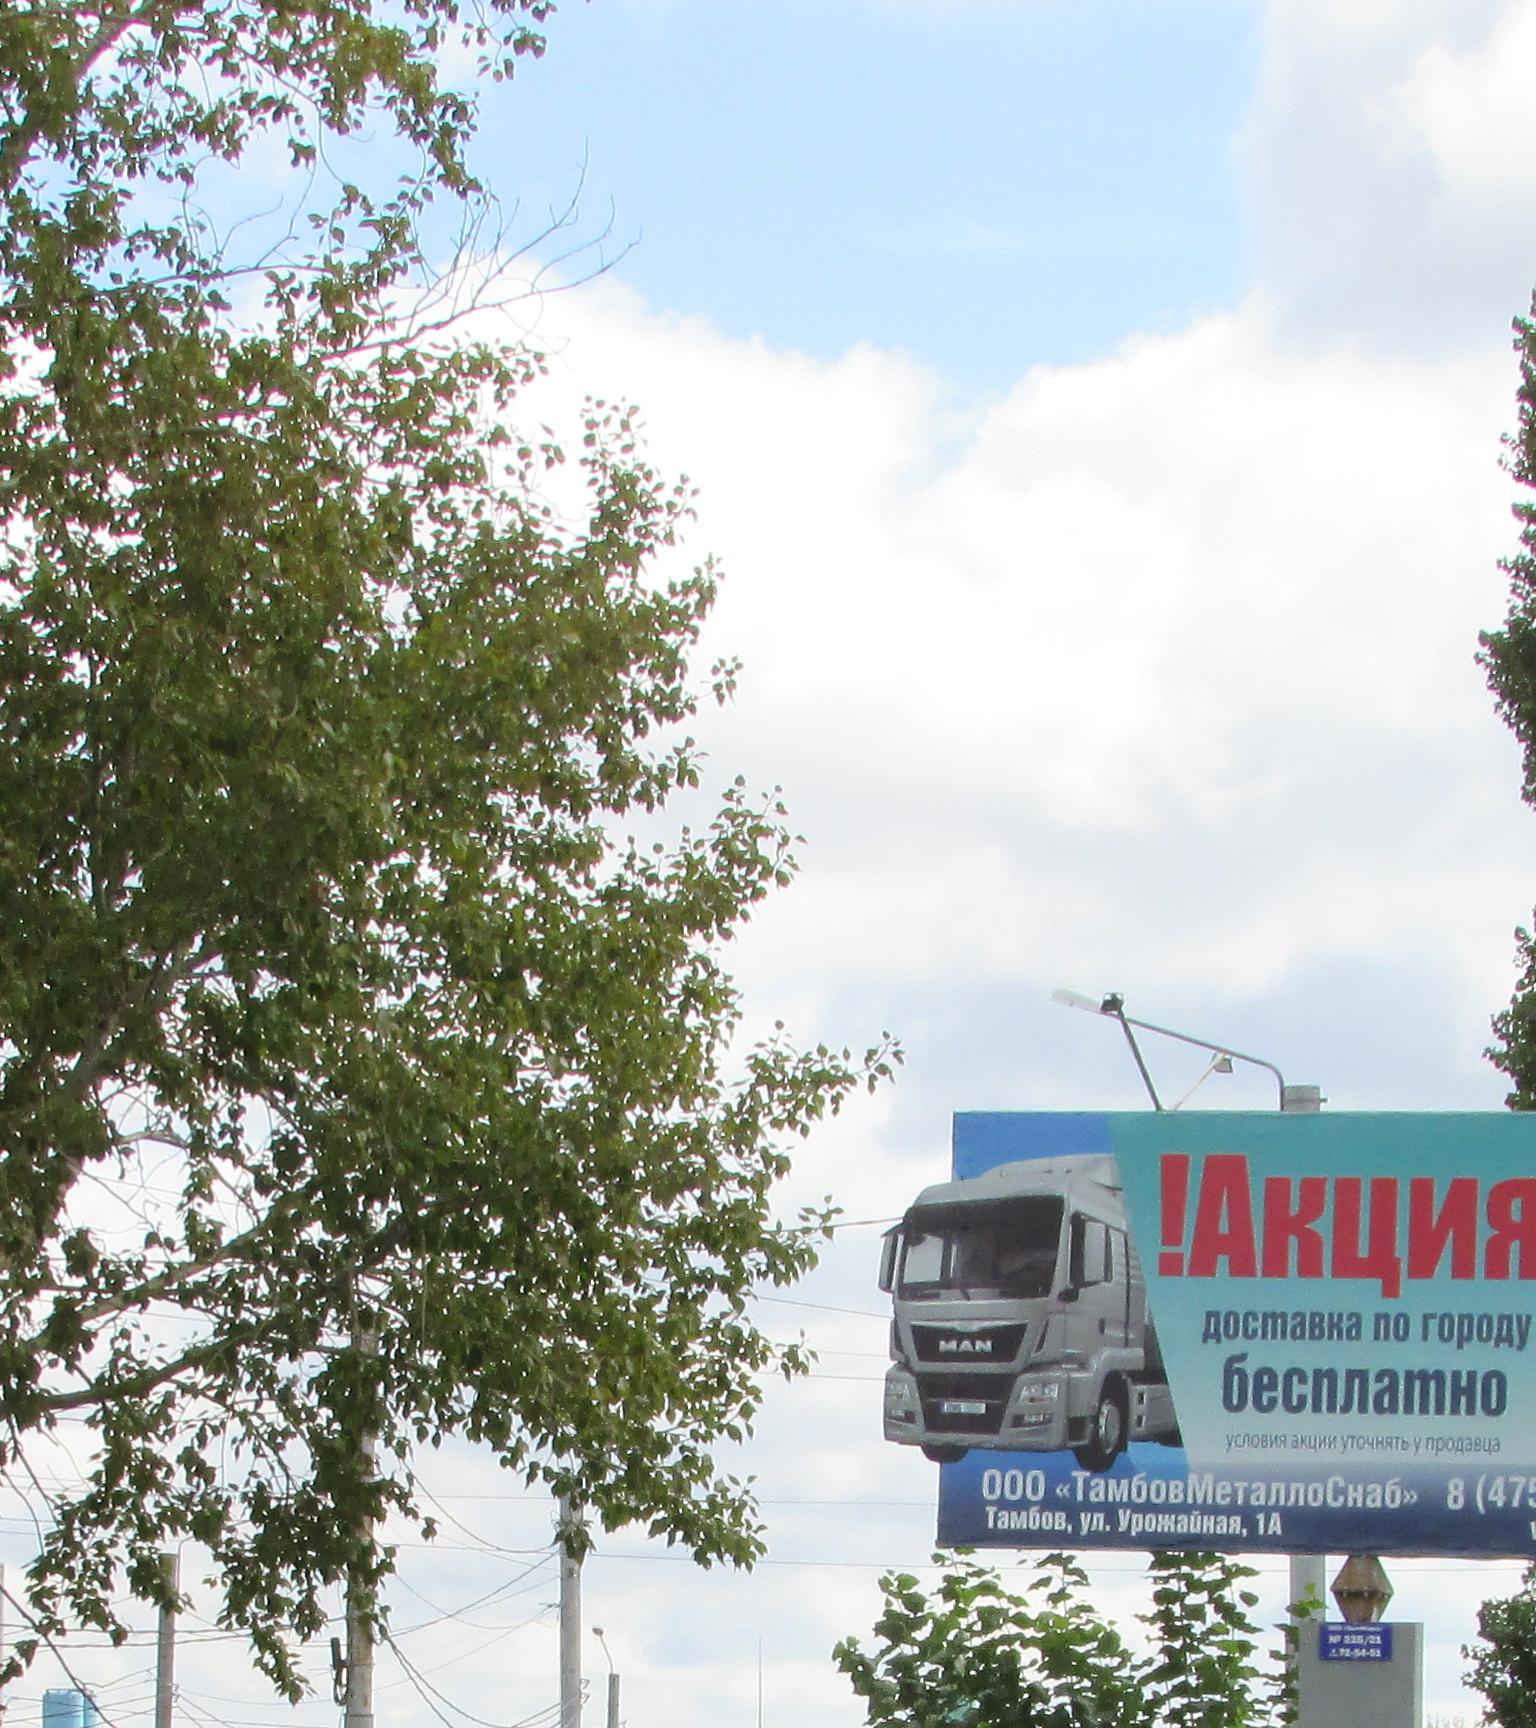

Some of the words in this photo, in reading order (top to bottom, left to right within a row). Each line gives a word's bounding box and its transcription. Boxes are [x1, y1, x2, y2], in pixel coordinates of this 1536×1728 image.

[939, 1340, 992, 1353] MAN
[1202, 1310, 1362, 1344] доставка
[1373, 1311, 1410, 1342] по
[1421, 1312, 1532, 1352] городу
[1221, 1352, 1508, 1417] бесплатно
[1225, 1434, 1287, 1452] условия
[1290, 1434, 1337, 1452] акции
[1340, 1434, 1409, 1453] уточнять
[1412, 1437, 1423, 1454] у
[1426, 1436, 1501, 1455] продавца
[982, 1469, 1046, 1501] ООО
[1055, 1471, 1418, 1509] «ТамбовМеталлоСнаб»
[1446, 1478, 1465, 1511] 8
[985, 1506, 1072, 1534] Тамбов,
[1079, 1511, 1111, 1537] ул.
[1117, 1508, 1248, 1538] Урожайная,
[1256, 1513, 1282, 1536] 1А
